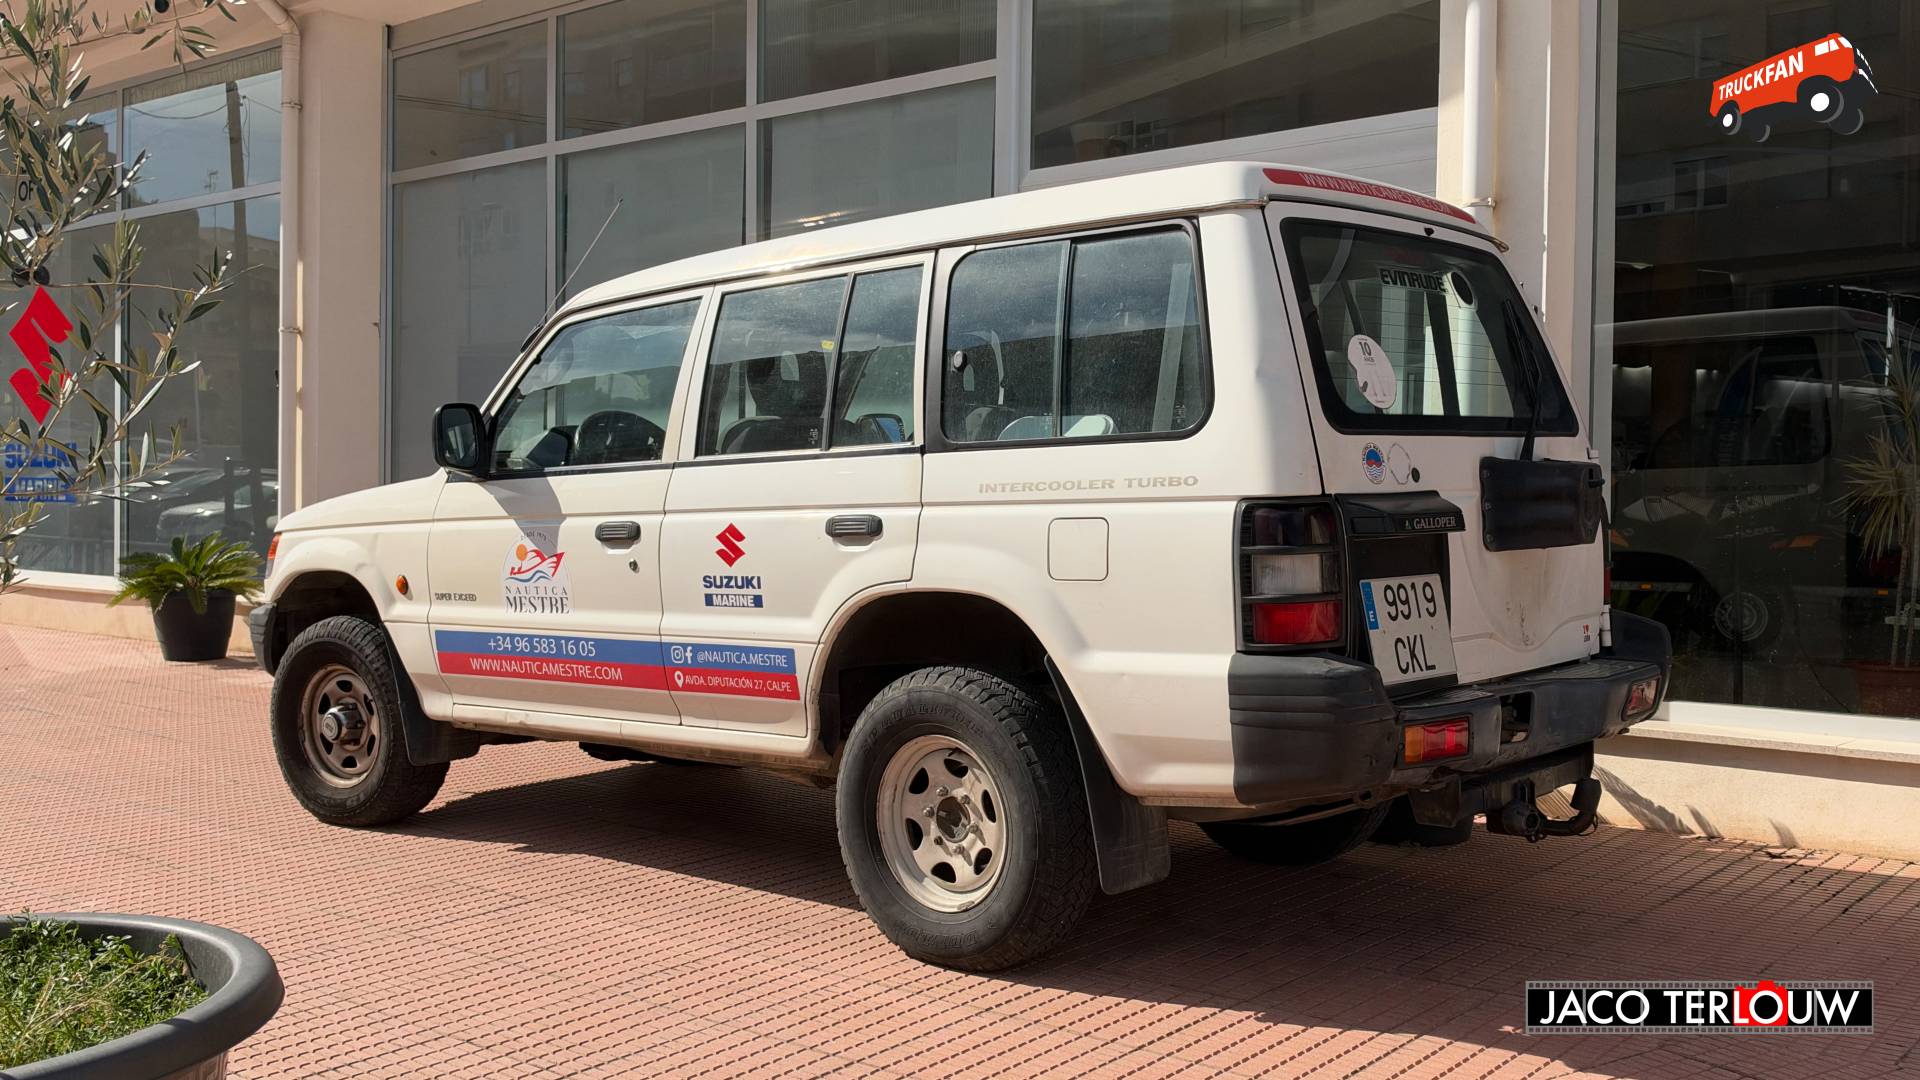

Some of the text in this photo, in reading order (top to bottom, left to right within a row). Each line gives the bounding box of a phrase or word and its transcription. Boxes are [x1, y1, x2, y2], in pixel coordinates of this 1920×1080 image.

[1380, 268, 1448, 293] EVINRUDE
[1358, 341, 1372, 356] 10
[978, 475, 1199, 494] INTERCOOLER TURBO
[1413, 516, 1457, 529] GALLOPER
[505, 585, 568, 596] NAUTICA
[702, 574, 762, 590] SUZUKI
[505, 595, 570, 614] MESTRE
[712, 594, 755, 607] MARINE
[1383, 581, 1437, 622] 9919
[1368, 610, 1376, 622] E
[488, 636, 596, 657] +34 96 583 16 05
[1394, 634, 1436, 675] CKL
[697, 651, 788, 667] @NAUTICA.MESTRE
[469, 657, 623, 681] WWW.NAUTICAMESTRE.COM
[685, 675, 705, 686] AVDA.
[708, 676, 753, 689] DIPUTACIÓN
[766, 681, 792, 692] CALPE
